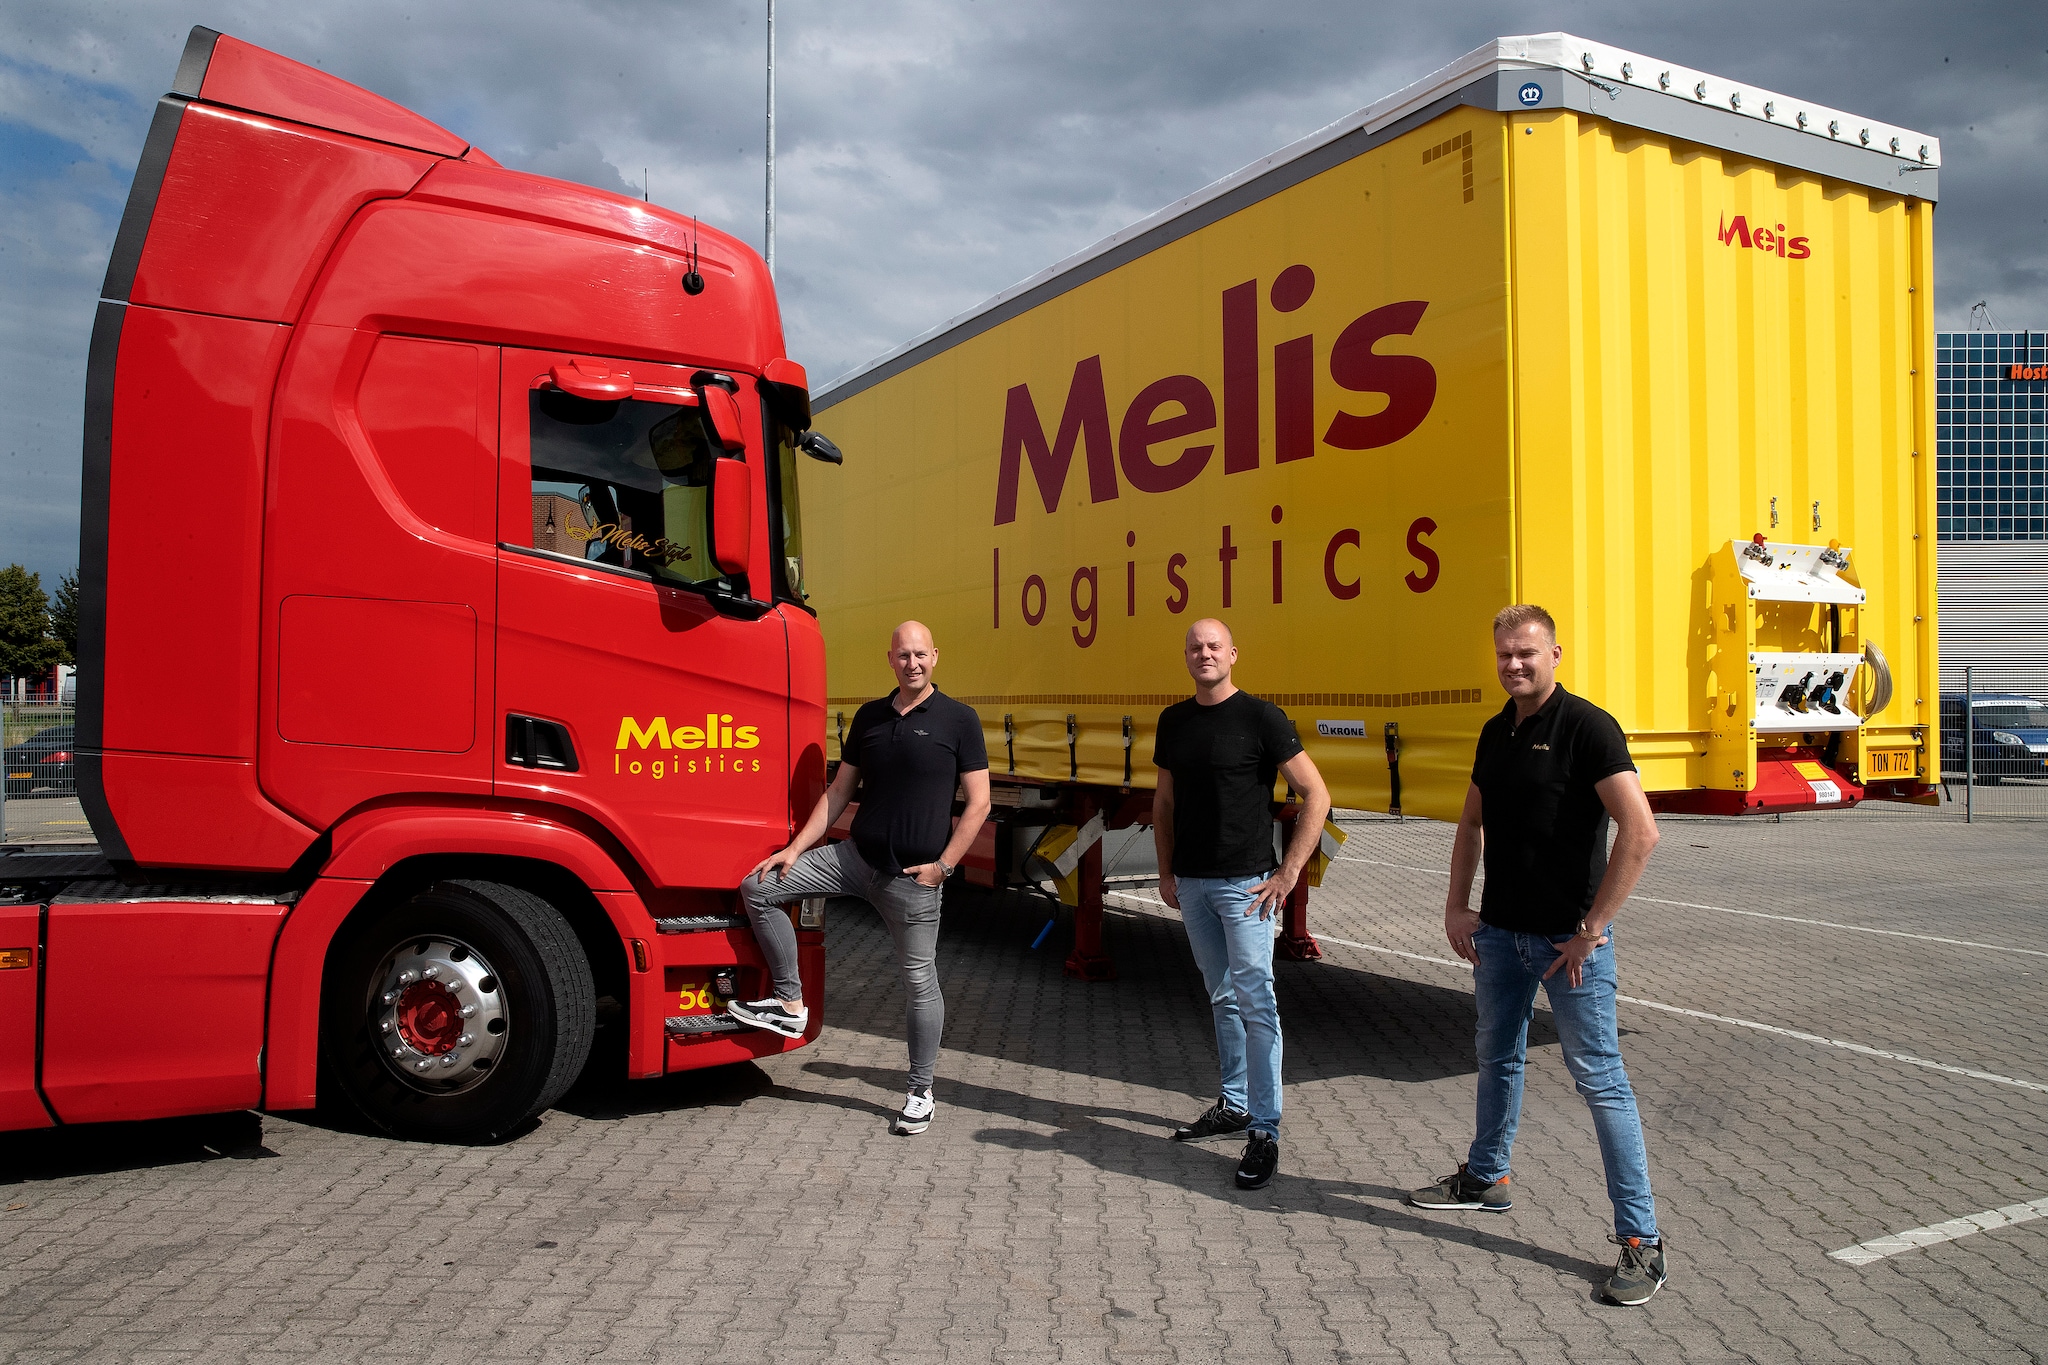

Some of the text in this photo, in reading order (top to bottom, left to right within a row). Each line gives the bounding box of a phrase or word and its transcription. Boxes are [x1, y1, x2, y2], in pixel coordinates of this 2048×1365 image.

[2010, 363, 2048, 380] Host
[993, 264, 1437, 526] Melis
[597, 523, 693, 568] Melis Style
[993, 504, 1440, 648] logistics
[615, 713, 760, 750] Melis
[1330, 727, 1364, 736] KRONE
[615, 753, 761, 780] logistics
[1872, 752, 1909, 772] TON 772
